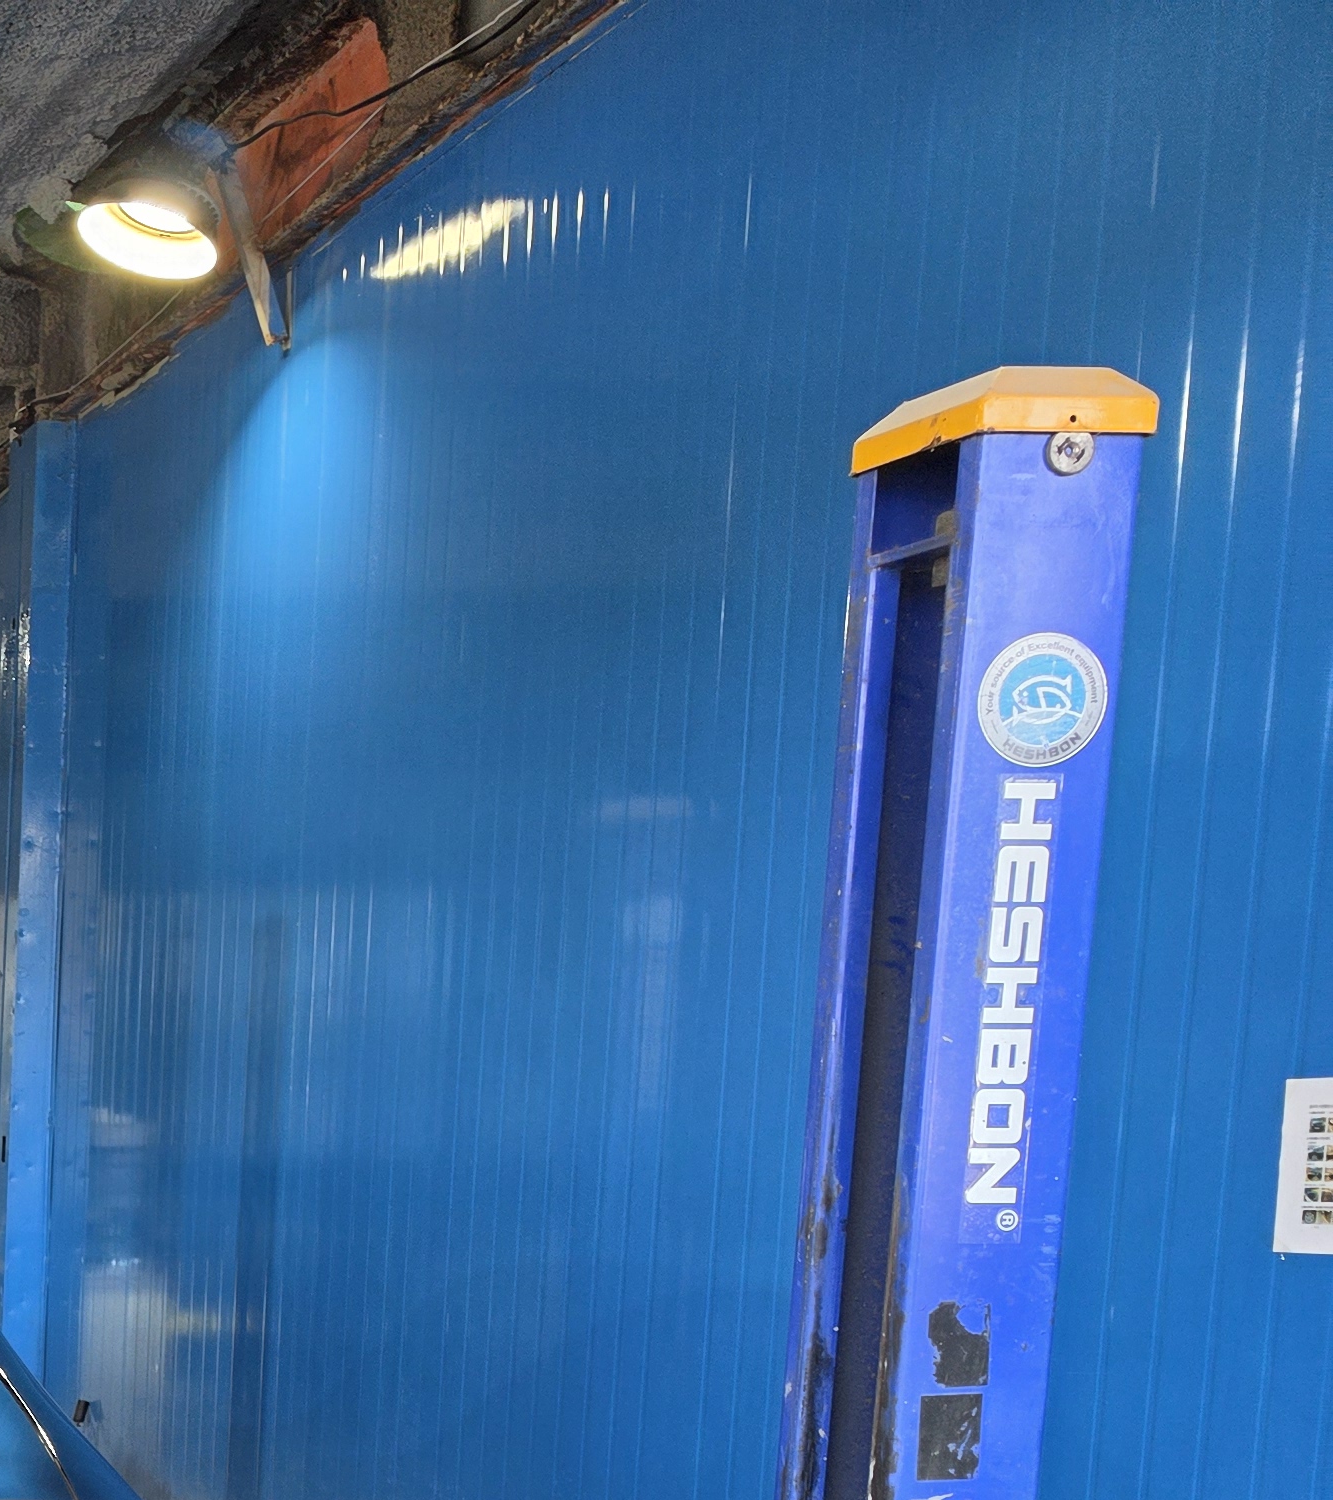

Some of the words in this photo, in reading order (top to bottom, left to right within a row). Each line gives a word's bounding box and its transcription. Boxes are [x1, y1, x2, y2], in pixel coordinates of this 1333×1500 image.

[985, 690, 995, 715] Your
[992, 655, 1016, 689] source
[1015, 646, 1026, 658] of
[1027, 641, 1075, 656] Excellent
[1074, 653, 1099, 704] equipment
[1002, 731, 1082, 760] HESHBON
[965, 781, 1057, 1205] HESHBON
